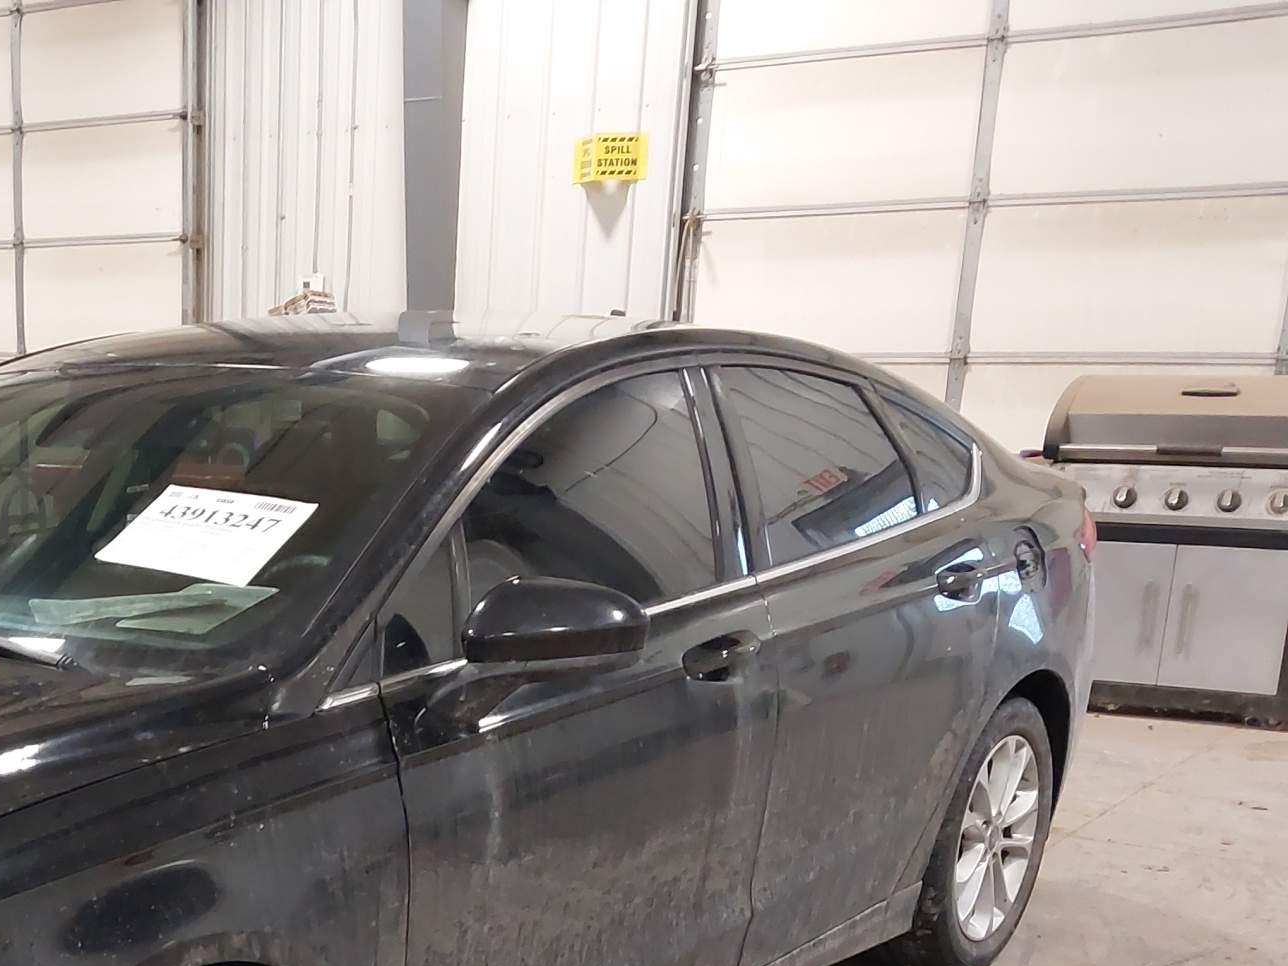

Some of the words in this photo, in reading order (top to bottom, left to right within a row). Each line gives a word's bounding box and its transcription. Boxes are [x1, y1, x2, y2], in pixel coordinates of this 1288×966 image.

[604, 145, 631, 154] SPILL
[596, 157, 638, 167] STATION
[160, 504, 282, 532] 43913247
